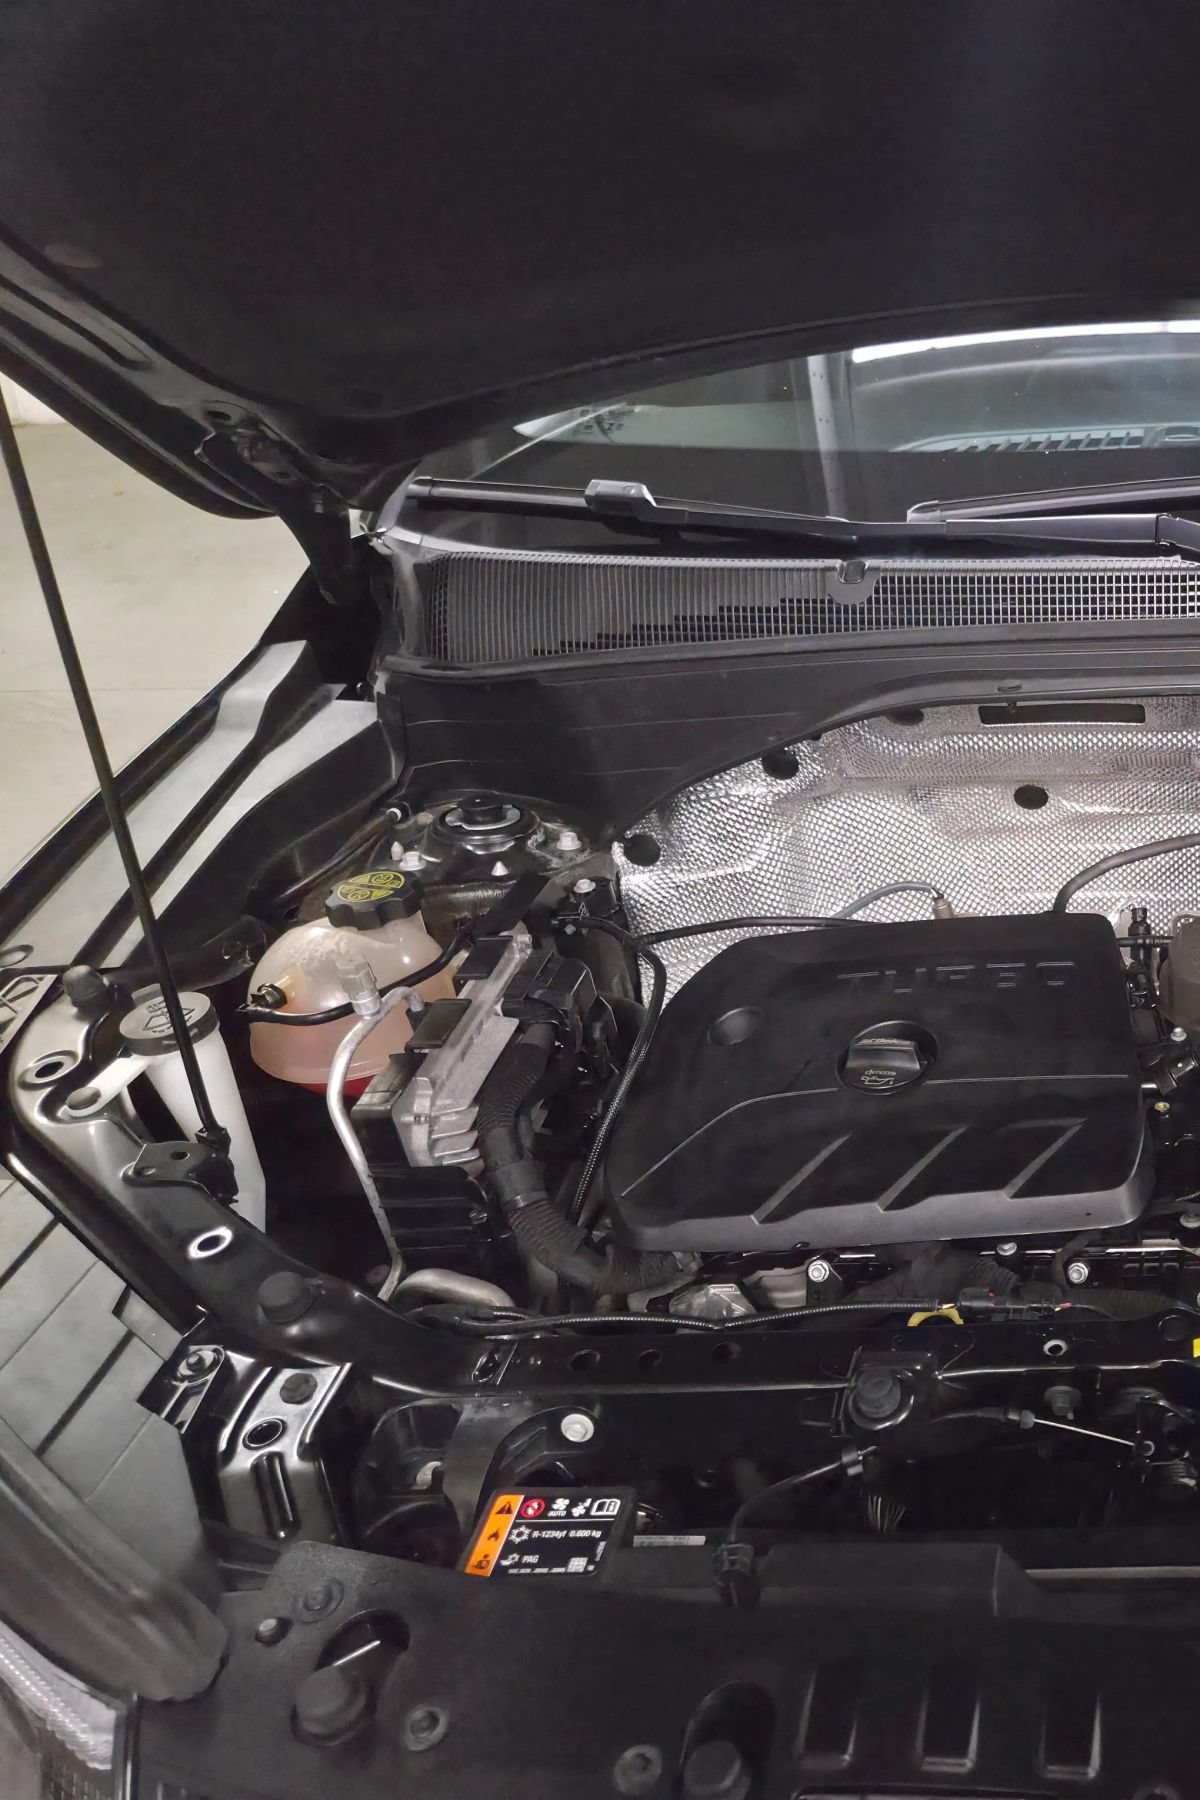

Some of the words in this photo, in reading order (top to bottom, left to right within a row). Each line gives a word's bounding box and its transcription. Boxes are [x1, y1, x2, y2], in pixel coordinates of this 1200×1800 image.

[836, 961, 1075, 998] TURBO
[591, 1530, 602, 1539] kg
[522, 1555, 539, 1564] PAG
